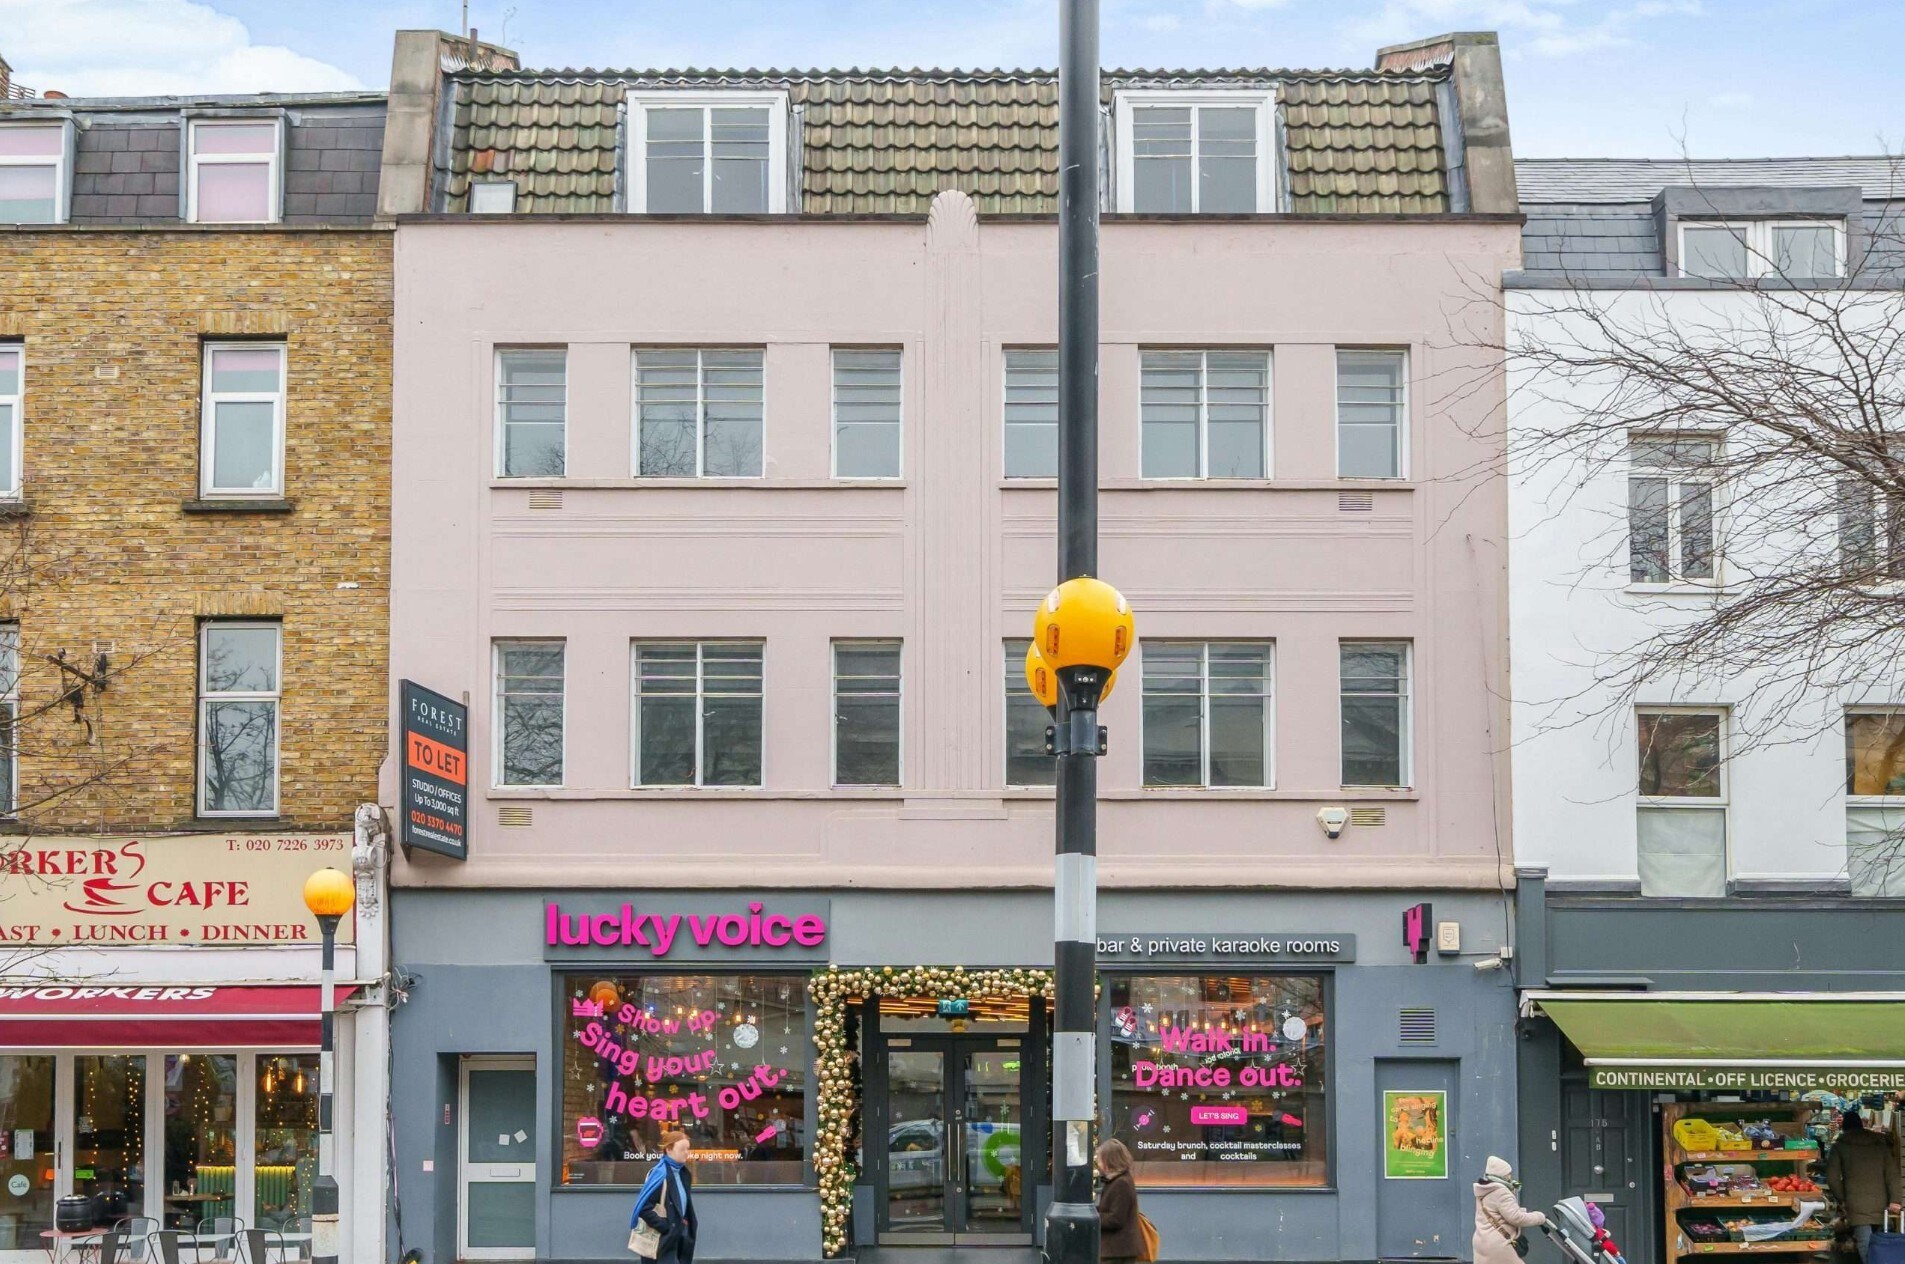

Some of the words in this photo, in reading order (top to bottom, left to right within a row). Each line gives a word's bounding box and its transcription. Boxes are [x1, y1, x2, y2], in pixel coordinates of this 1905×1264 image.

[412, 698, 462, 730] FOREST
[417, 715, 432, 726] REAL
[435, 723, 457, 736] ESTATE
[414, 740, 433, 765] TO
[437, 749, 460, 776] LET
[412, 778, 434, 794] STUDIO
[437, 788, 462, 804] OFFICES
[414, 793, 424, 806] Up
[424, 795, 431, 807] To
[431, 798, 447, 812] 3,000
[447, 805, 455, 816] sq
[454, 805, 460, 817] ft
[411, 810, 426, 825] 020
[427, 815, 445, 831] 3370
[445, 821, 463, 836] 4470
[226, 839, 240, 851] T:
[246, 839, 271, 851] 020
[277, 839, 308, 851] 7226
[313, 839, 344, 851] 3973
[147, 881, 249, 911] CAFE
[73, 925, 168, 941] LUNCH
[201, 924, 308, 941] DINNER
[547, 903, 682, 956] lucky
[688, 901, 826, 947] voice
[1096, 938, 1125, 953] bar
[1130, 938, 1143, 953] &
[1149, 937, 1206, 956] private
[1212, 938, 1280, 953] karaoke
[1286, 940, 1340, 953] rooms
[618, 1003, 681, 1034] Show
[579, 1021, 640, 1076] Sing
[646, 1049, 716, 1083] your
[1159, 1026, 1233, 1052] Walk
[1243, 1026, 1276, 1052] in.
[1136, 1060, 1230, 1087] Dance
[1240, 1063, 1301, 1087] out.
[1596, 1072, 1705, 1086] CONTINENTAL
[1716, 1073, 1746, 1086] OFF
[1750, 1073, 1817, 1087] LICENCE
[605, 1081, 710, 1121] heart
[718, 1064, 788, 1110] out.
[1220, 1112, 1239, 1120] SING
[624, 1151, 645, 1160] Book
[701, 1151, 723, 1161] night
[1137, 1141, 1176, 1151] Saturday
[1177, 1141, 1208, 1151] brunch,
[1210, 1141, 1242, 1150] cocktail
[1243, 1141, 1301, 1150] masterclasses
[1181, 1152, 1196, 1160] and
[1220, 1151, 1257, 1160] cocktails
